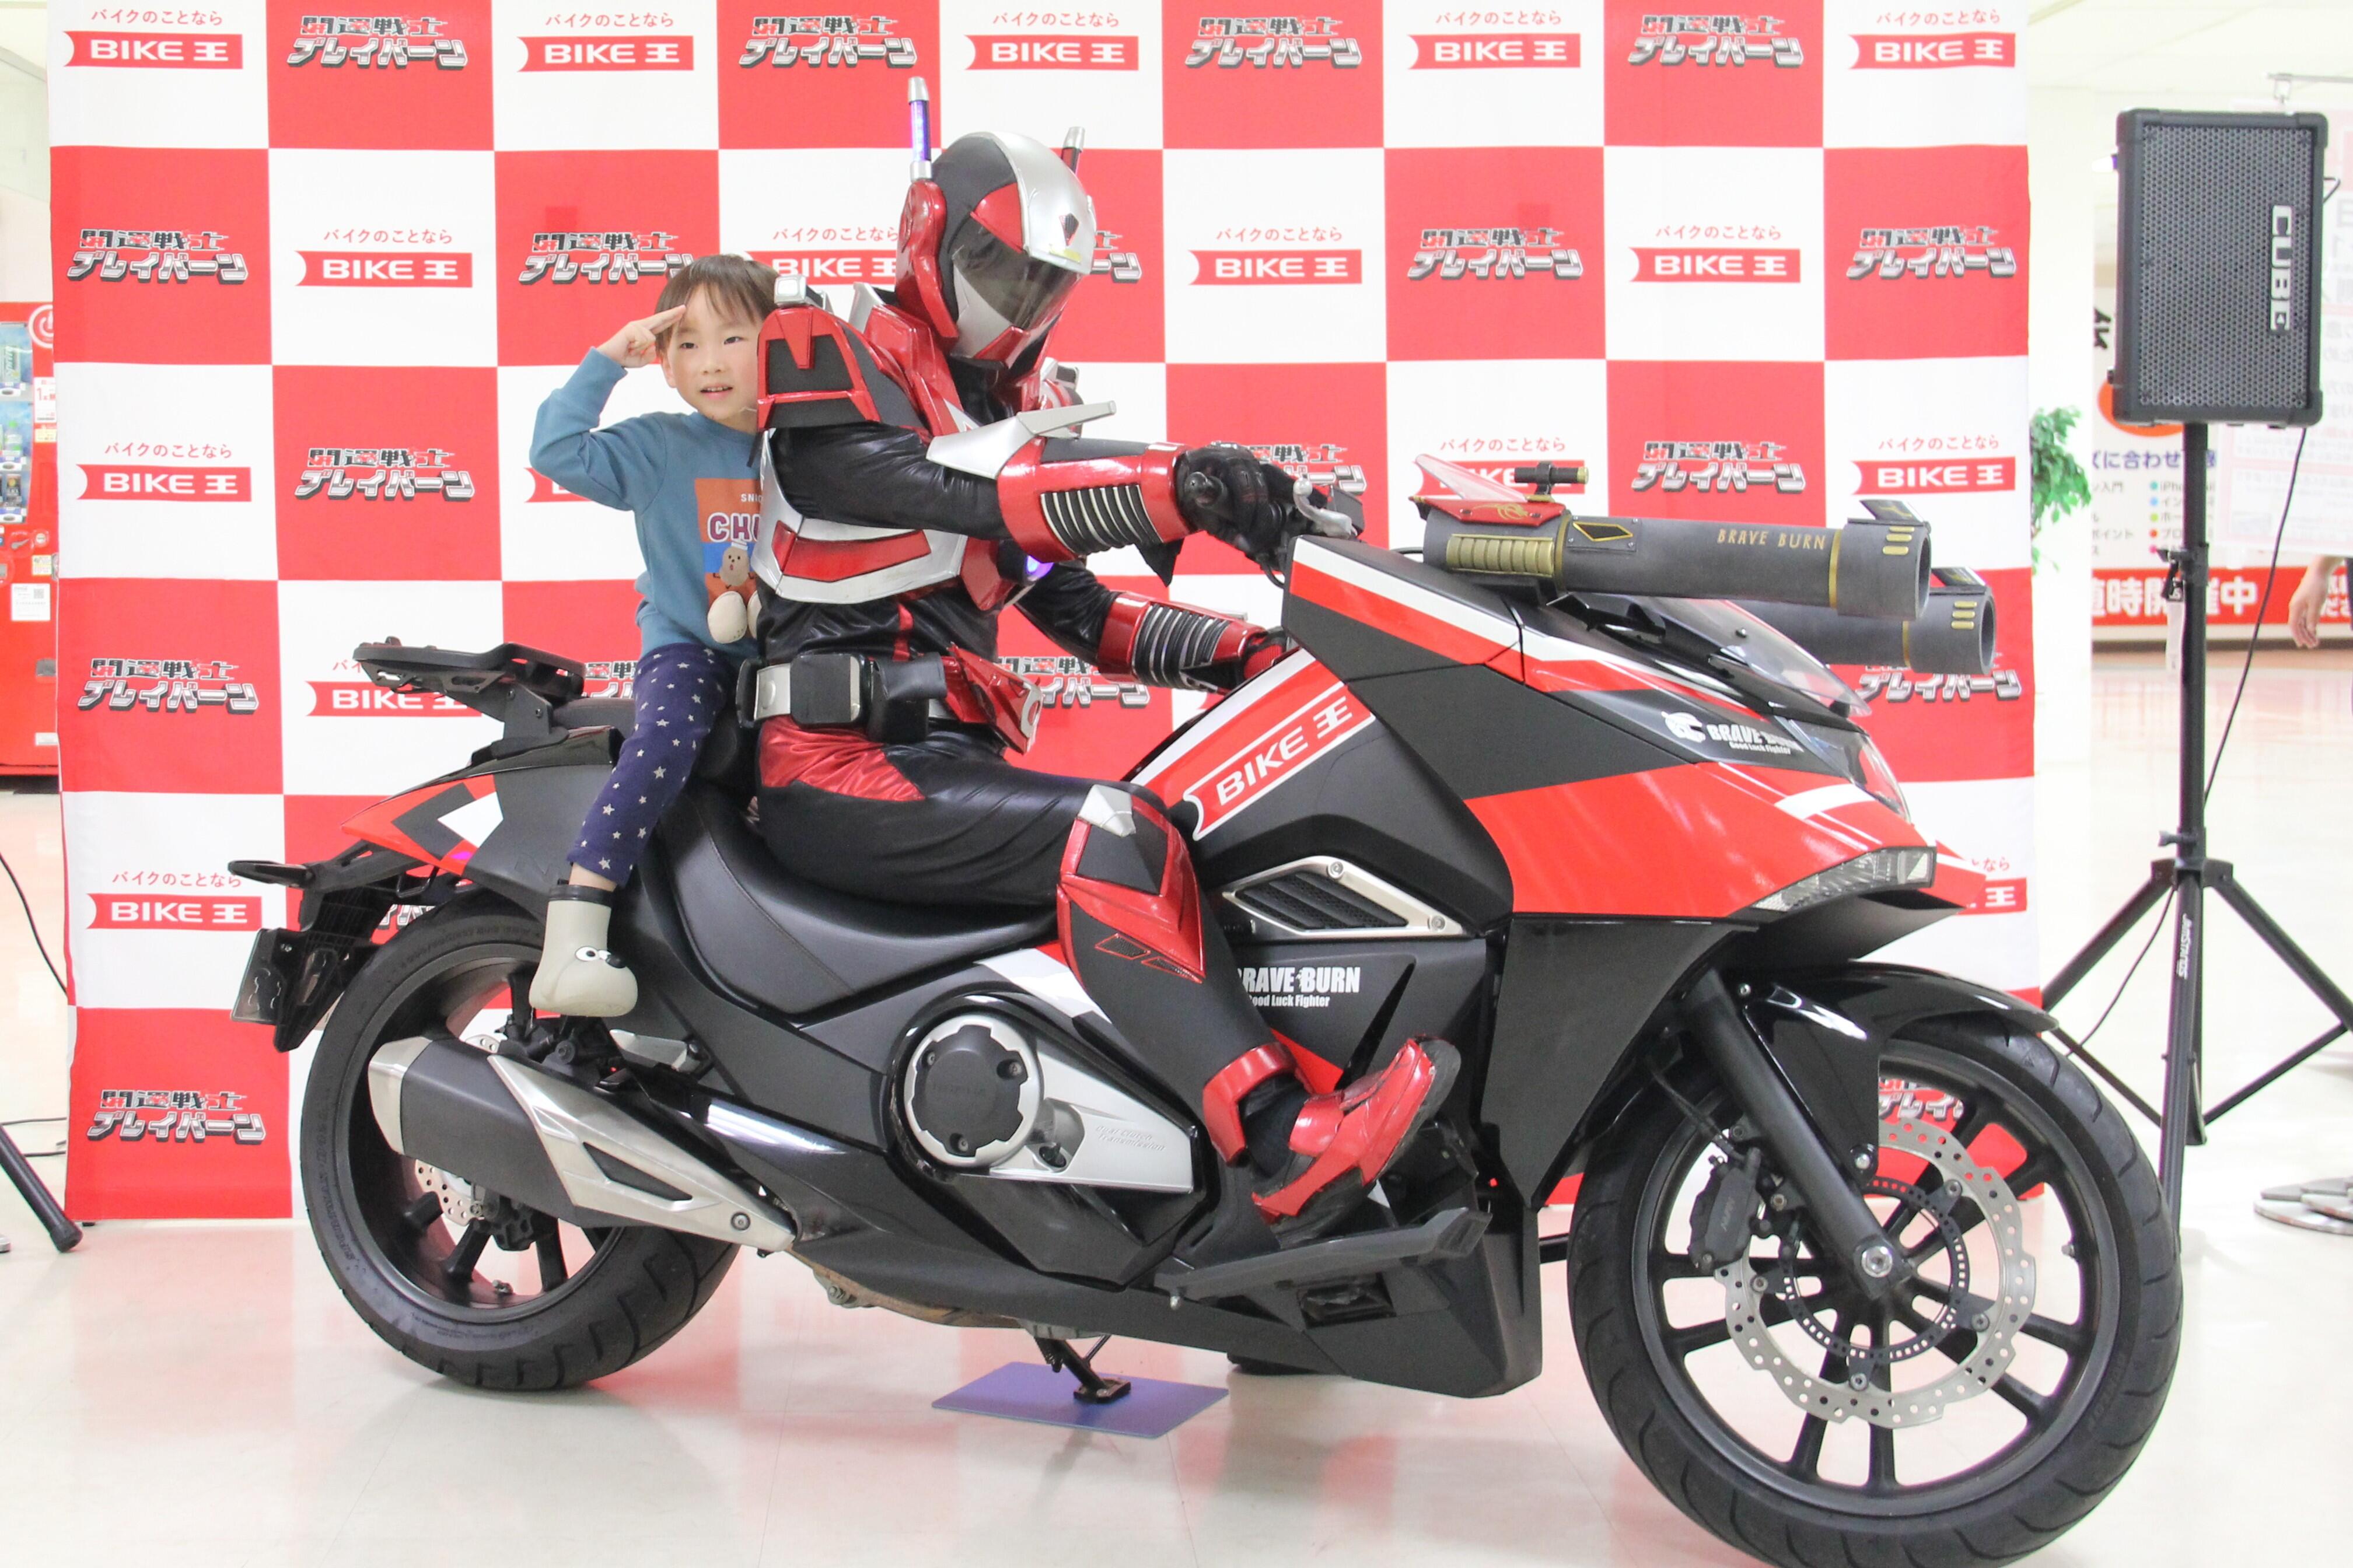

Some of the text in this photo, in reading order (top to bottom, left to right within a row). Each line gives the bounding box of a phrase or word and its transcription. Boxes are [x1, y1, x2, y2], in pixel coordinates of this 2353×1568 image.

[91, 9, 223, 26] バイクのことなら
[546, 13, 674, 27] バイクのことなら
[993, 12, 1120, 27] バイクのことなら
[1436, 10, 1561, 25] バイクのことなら
[1876, 9, 2001, 25] バイクのことなら
[91, 40, 183, 61] BIKE
[287, 37, 468, 71] ブレイバーン
[545, 44, 635, 63] BIKE
[739, 36, 918, 68] ブレイバーン
[992, 43, 1081, 62] BIKE
[1185, 37, 1362, 68] ブレイバーン
[1435, 41, 1523, 61] BIKE
[1628, 36, 1804, 68] ブレイバーン
[1875, 40, 1964, 62] BIKE
[324, 229, 452, 244] バイクのことなら
[773, 227, 898, 242] バイクのことなら
[1217, 227, 1342, 242] バイクのことなら
[1656, 225, 1782, 240] バイクのことなら
[67, 251, 249, 284] ブレイバーン
[323, 260, 414, 279] BIKE
[772, 258, 862, 277] BIKE
[1216, 258, 1305, 277] BIKE
[1407, 249, 1583, 281] ブレイバーン
[1655, 256, 1744, 275] BIKE
[1846, 246, 2017, 279] ブレイバーン
[105, 442, 232, 459] バイクのことなら
[1441, 438, 1565, 452] バイクのことなら
[1879, 434, 1999, 451] バイクのことなら
[104, 473, 195, 494] BIKE
[295, 469, 475, 502] ブレイバーン
[1631, 460, 1806, 494] ブレイバーン
[1877, 466, 1966, 488] BIKE
[1717, 528, 1826, 550] BRAVE BURN
[78, 680, 259, 715] ブレイバーン
[1041, 677, 1151, 708] イバーン
[1706, 723, 1763, 744] BRAVE
[1216, 726, 1308, 806] BIKE
[113, 870, 242, 888] バイクのことなら
[111, 902, 202, 922] BIKE
[1237, 967, 1361, 993] RAVE BURN
[1250, 994, 1331, 1009] ood Luck Fighter
[87, 1111, 267, 1144] ブレイバーン
